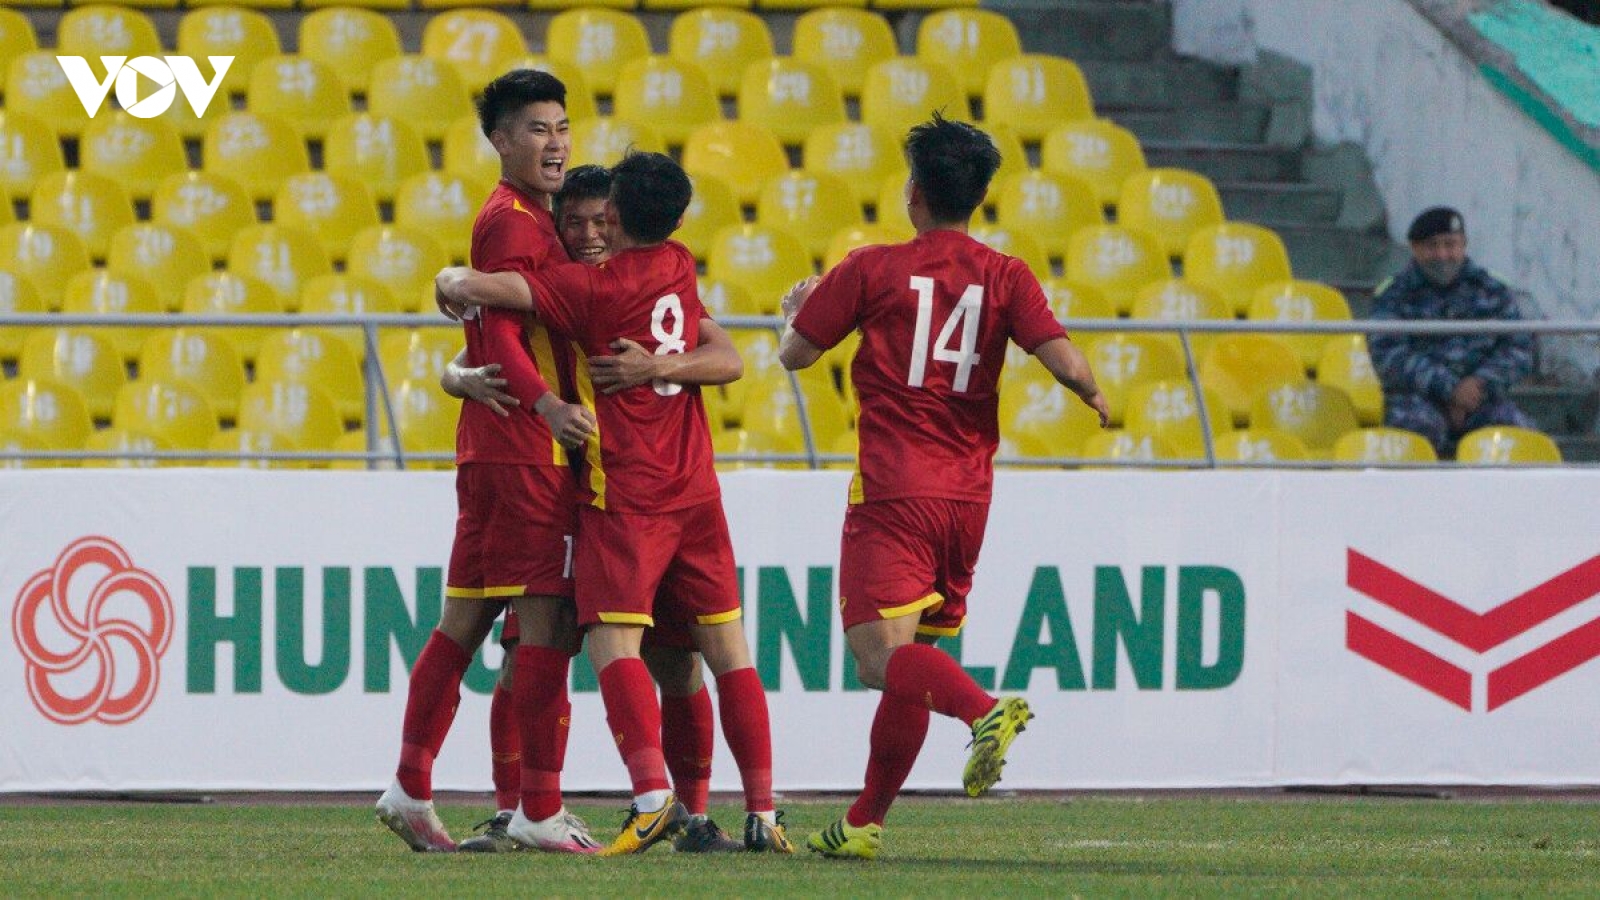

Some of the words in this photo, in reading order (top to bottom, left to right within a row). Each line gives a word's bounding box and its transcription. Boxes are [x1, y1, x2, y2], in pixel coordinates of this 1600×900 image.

[446, 17, 498, 65] 27
[650, 292, 686, 397] 8
[907, 275, 984, 393] 14
